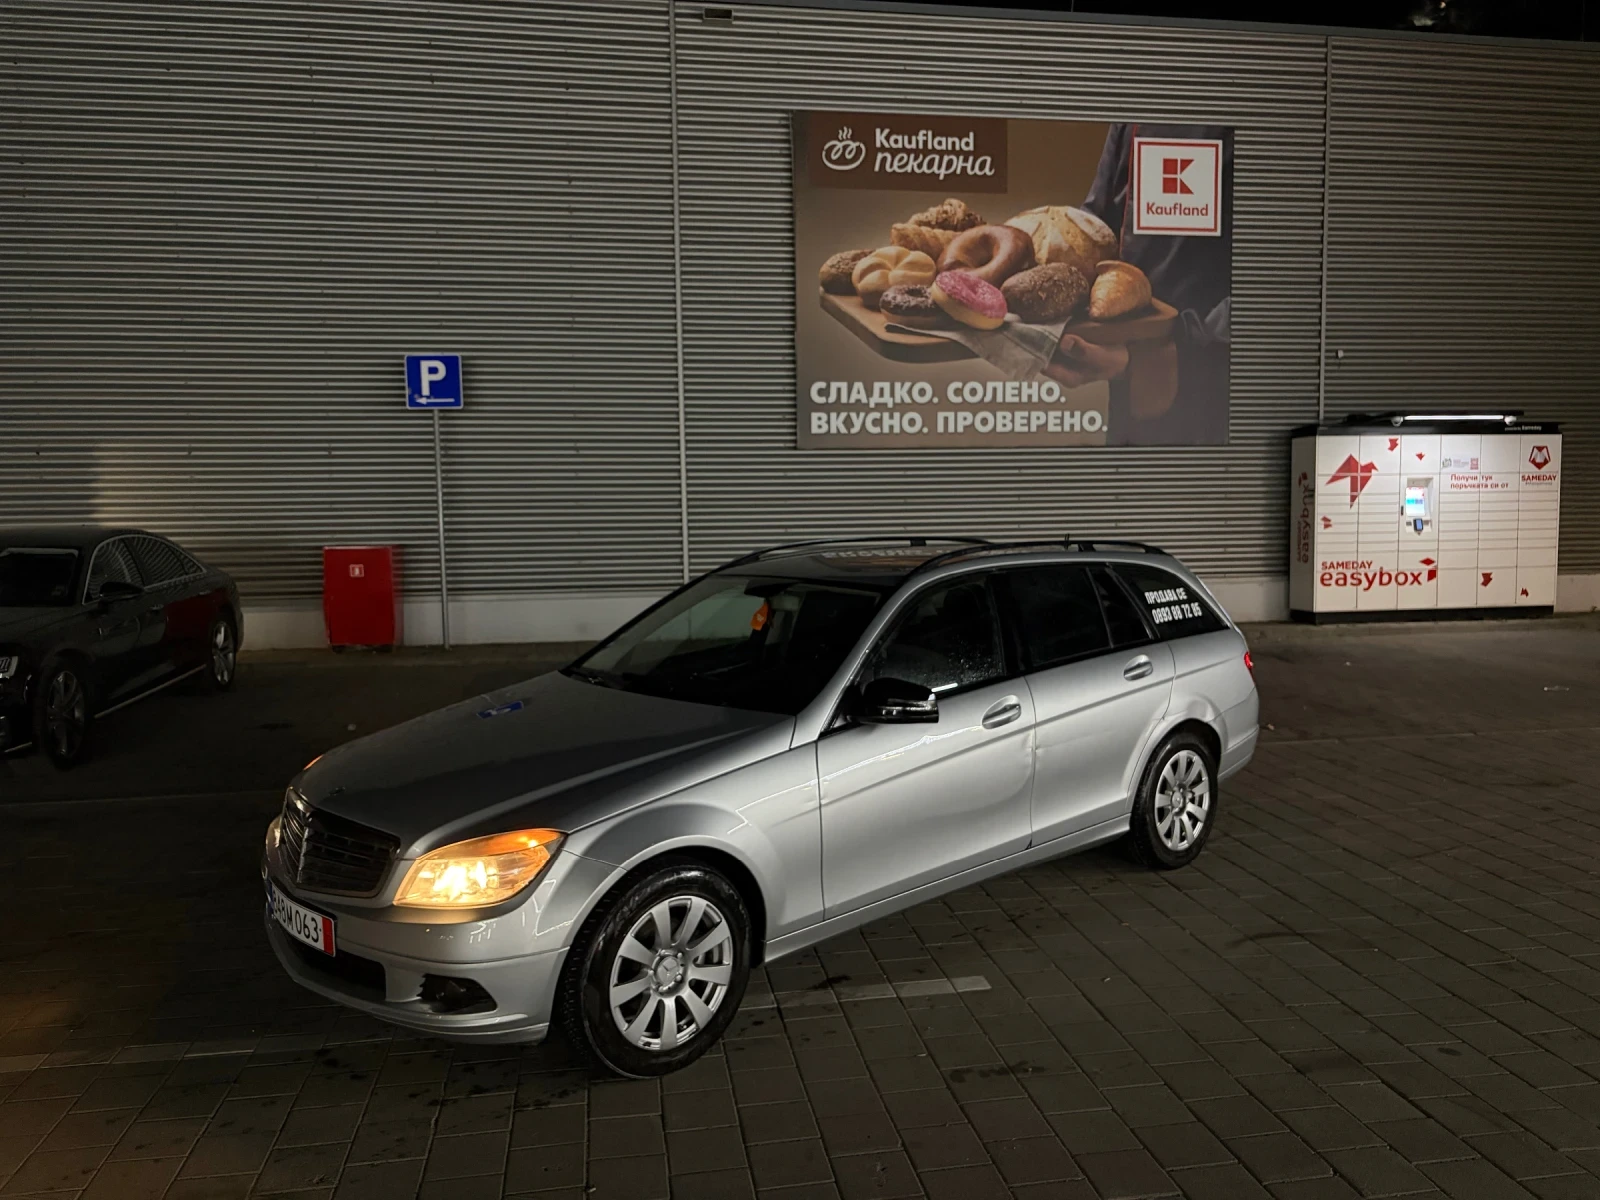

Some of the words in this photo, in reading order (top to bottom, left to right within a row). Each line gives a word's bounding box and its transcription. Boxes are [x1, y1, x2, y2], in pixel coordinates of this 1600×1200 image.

[875, 128, 974, 151] Kaufland
[874, 151, 995, 180] пекарна
[1146, 202, 1208, 216] Kaufland
[420, 360, 446, 396] P
[810, 381, 938, 408] СЛАДКО.
[947, 381, 1066, 403] СОЛЕНО.
[810, 411, 929, 434] ВКУСНО.
[937, 410, 1108, 433] ПРОВЕРЕНО.
[1321, 560, 1373, 570] SAMEDAY
[1320, 567, 1422, 592] easybox
[1144, 589, 1178, 604] ПРОДАВА
